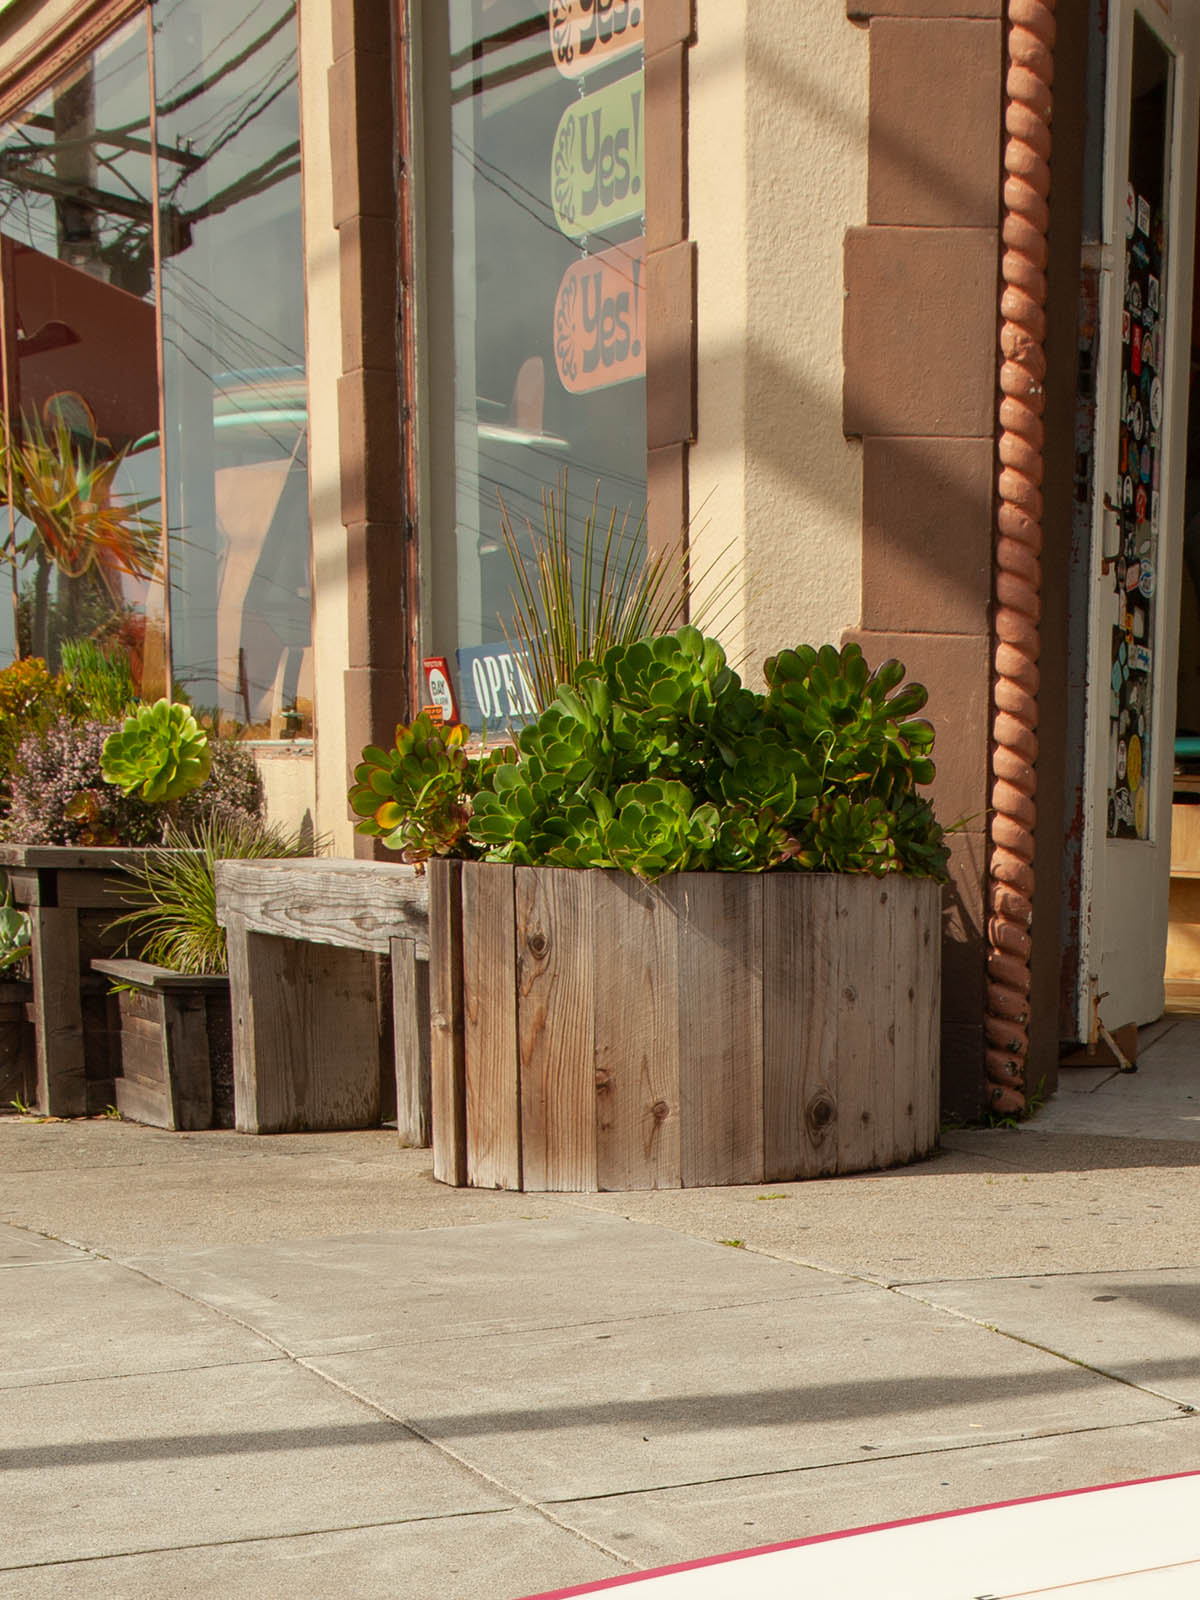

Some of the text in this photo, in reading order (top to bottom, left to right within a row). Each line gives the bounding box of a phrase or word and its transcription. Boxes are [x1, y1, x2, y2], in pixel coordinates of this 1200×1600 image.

[580, 0, 641, 54] Yes
[579, 90, 641, 216] Yes!
[581, 257, 641, 373] Yes!
[472, 651, 539, 718] OPEN
